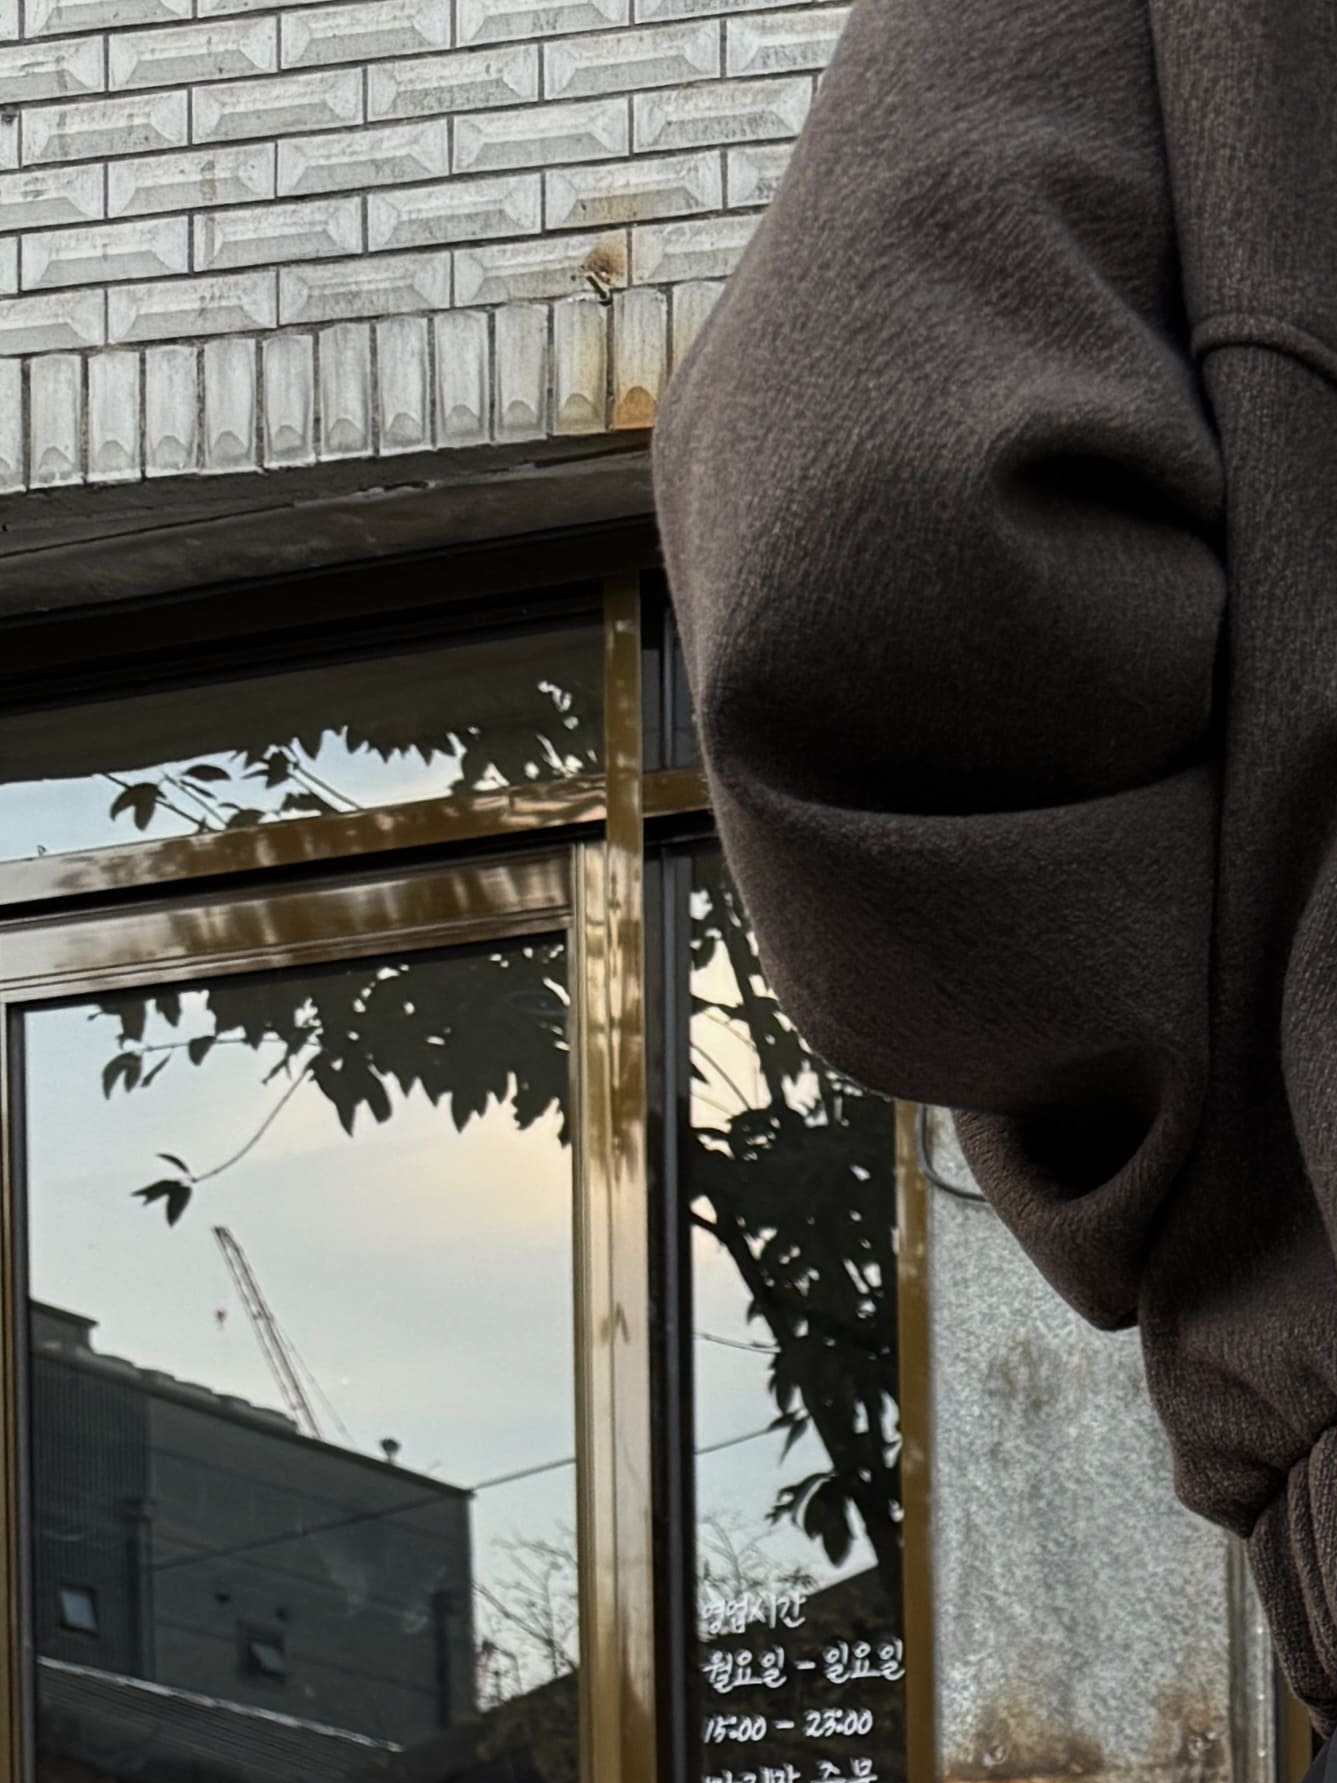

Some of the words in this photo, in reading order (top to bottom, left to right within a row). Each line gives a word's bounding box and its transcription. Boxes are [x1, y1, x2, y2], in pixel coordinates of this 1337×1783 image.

[703, 1591, 807, 1634] 영업시간
[701, 1646, 788, 1694] 월요일
[822, 1637, 906, 1684] 일요일
[703, 1714, 768, 1743] 15:00
[804, 1708, 874, 1737] 23:00
